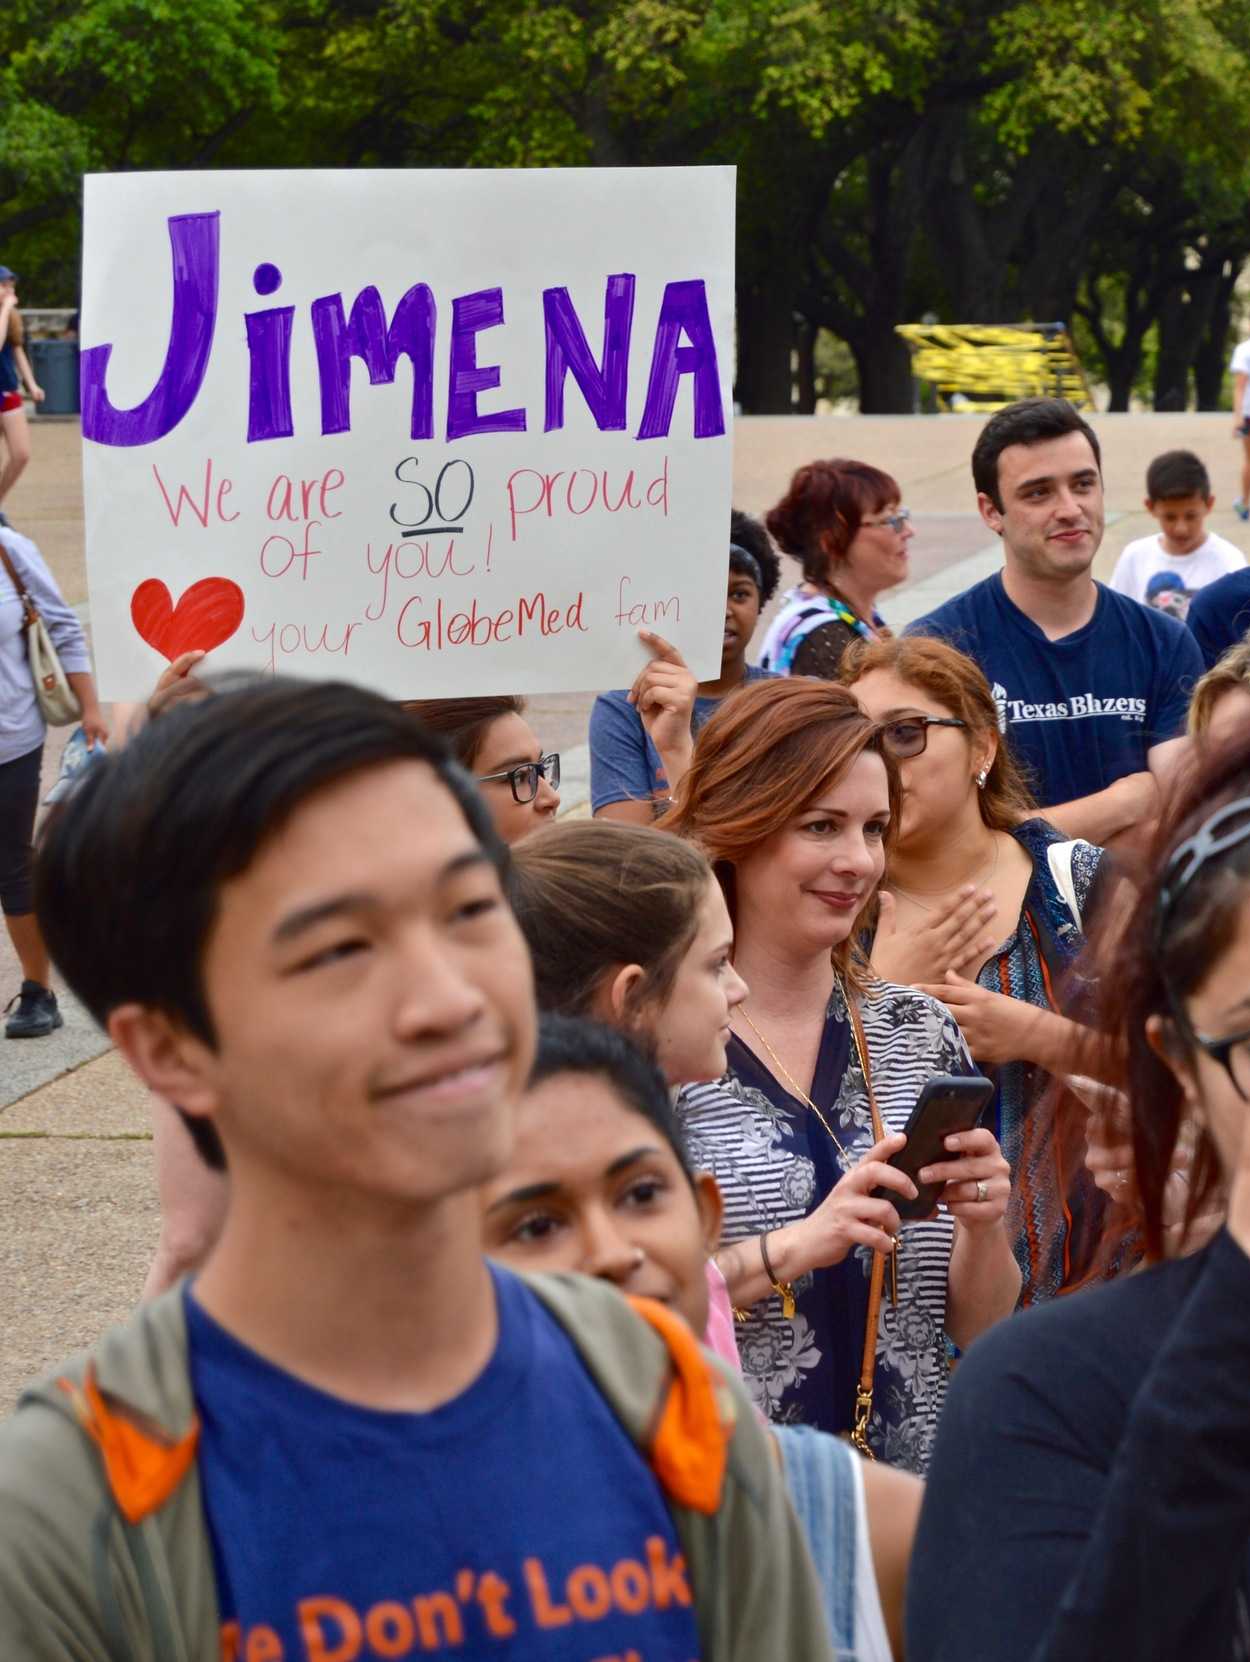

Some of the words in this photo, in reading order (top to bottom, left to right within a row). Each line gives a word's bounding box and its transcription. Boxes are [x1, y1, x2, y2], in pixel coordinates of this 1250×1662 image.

[152, 458, 240, 527] We
[265, 467, 345, 521] are
[389, 456, 475, 537] SO
[507, 456, 669, 541] proud
[260, 520, 323, 580] of
[366, 524, 494, 621] you!
[251, 620, 363, 680] your
[396, 592, 588, 651] GlobeMed
[614, 576, 682, 624] fam
[1008, 700, 1068, 720] Texas
[298, 1567, 516, 1662] Don't
[522, 1535, 693, 1628] Look
